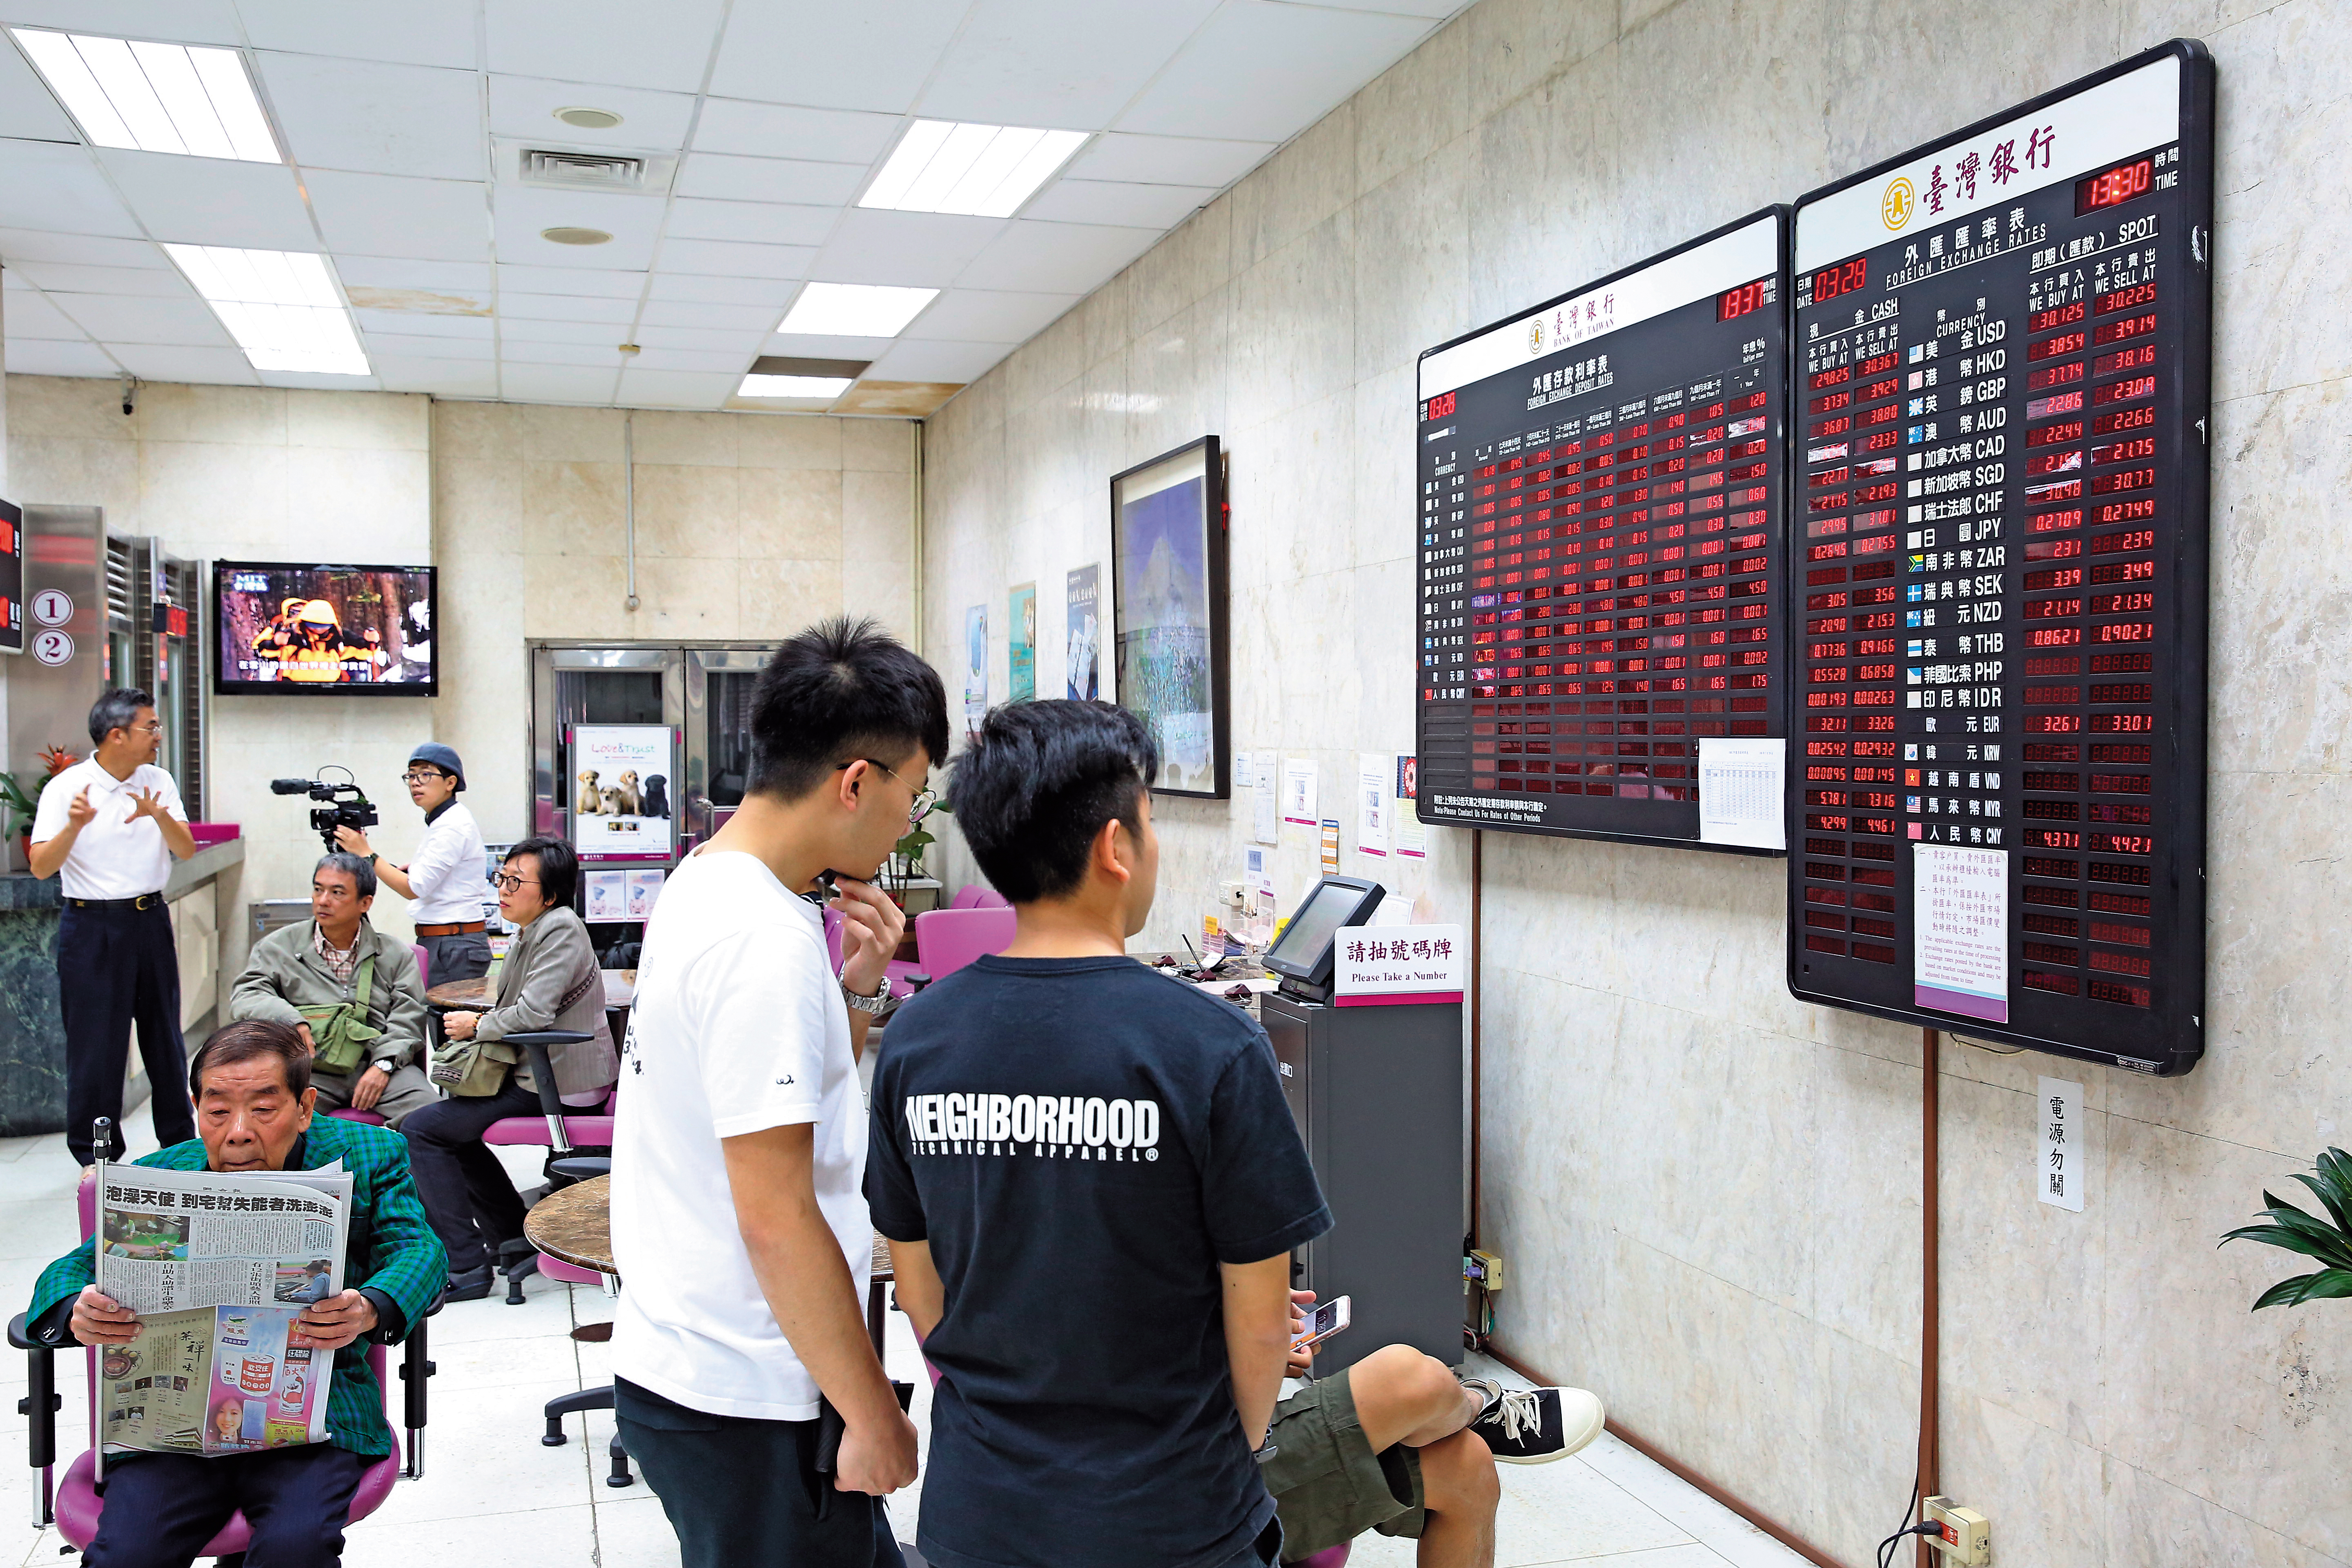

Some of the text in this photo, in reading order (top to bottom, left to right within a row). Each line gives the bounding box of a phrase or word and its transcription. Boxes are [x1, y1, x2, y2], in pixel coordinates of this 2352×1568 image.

[2155, 148, 2178, 168] 時間
[1923, 126, 2055, 215] 臺灣銀行
[2090, 162, 2149, 205] 13:30
[2155, 174, 2177, 191] TIME
[1904, 207, 2024, 267] 外匯匯率表
[2119, 216, 2156, 241] SPOT
[1886, 223, 2046, 288] FOREIGN EXCHANGE RATES
[2096, 248, 2156, 276] 本行賣出
[1763, 278, 1776, 292] 時間
[1798, 276, 1811, 291] 日期
[1815, 258, 1866, 302] 0328
[2030, 270, 2084, 296] 本行買入
[2096, 265, 2156, 294] WE SELL AT
[1763, 290, 1776, 305] TIME
[1797, 293, 1812, 309] DATE
[2029, 285, 2083, 312] WE BUY AT
[2107, 283, 2154, 310] 30.225
[1554, 293, 1614, 336] 臺灣銀行
[1872, 298, 1898, 319] CASH
[2040, 303, 2082, 328] 30.125
[1554, 317, 1614, 347] BANK OF TAIWAN
[1855, 323, 1898, 345] 本行賣出
[1937, 312, 1985, 338] CURRENCY
[1977, 320, 2005, 345] USD
[2116, 315, 2155, 338] 3.914
[1809, 338, 1848, 359] 本行買入
[1855, 337, 1898, 360] WE SELL AT
[2049, 334, 2082, 355] 3.854
[1809, 351, 1848, 373] WE BUY AT
[1865, 352, 1898, 374] 30.367
[1976, 350, 2005, 374] HKD
[2116, 346, 2154, 368] 38.16
[1532, 354, 1607, 395] 外匯存款利率表
[1817, 367, 1848, 387] 29.825
[2049, 363, 2082, 384] 37.74
[1528, 373, 1613, 408] FOREIGN EXCHANGE DEPOSIT RATES
[1689, 379, 1721, 395] 九個月未滿一年
[1977, 378, 2005, 401] GBP
[1429, 392, 1455, 421] 0328
[1977, 407, 2005, 431] AUD
[1925, 435, 2005, 469] 加拿大幣 CAD
[1435, 463, 1455, 476] CURRENCY
[1924, 464, 2005, 495] 新加坡幣 SGD
[1925, 491, 2004, 521] 瑞士法郎 CHF
[2104, 500, 2152, 521] 0.2749
[1976, 518, 2001, 540] JPY
[2037, 511, 2080, 530] 0.2709
[1977, 546, 2005, 568] ZAR
[1975, 574, 2003, 595] SEK
[46, 598, 59, 618] 1
[1974, 601, 2001, 622] NZD
[46, 637, 60, 657] 2
[1976, 633, 2003, 653] THB
[1815, 668, 1846, 682] 0.5528
[1861, 664, 1894, 679] 0.6858
[1924, 662, 2002, 684] 菲國比索 PHP
[1457, 688, 1465, 699] CNY
[1975, 688, 2001, 707] IDR
[1984, 717, 1999, 732] EUR
[2044, 717, 2079, 731] 32.61
[2113, 715, 2151, 731] 33.01
[1984, 746, 2000, 761] KRW
[1985, 773, 2000, 789] VND
[1458, 808, 1473, 817] Contact
[1490, 811, 1502, 819] Rates
[1524, 813, 1541, 822] Periods
[1985, 800, 2000, 817] MYR
[1821, 817, 1846, 829] 4.299
[1869, 819, 1894, 832] 4.461
[1987, 829, 2001, 844] CNY
[2045, 832, 2078, 846] 4.371
[2112, 835, 2150, 852] 4.421
[1348, 938, 1452, 962] 請抽號碼牌
[1352, 972, 1379, 982] Please
[1383, 972, 1403, 981] Take
[1414, 971, 1447, 980] Number
[906, 1092, 1159, 1148] NEIGHBORHOOD
[913, 1142, 1016, 1157] TECHNICAL
[2049, 1096, 2065, 1197] 電源勿關
[106, 1185, 175, 1207] 泡澡天使
[182, 1193, 333, 1218] 到宅幫失能者洗澎澎
